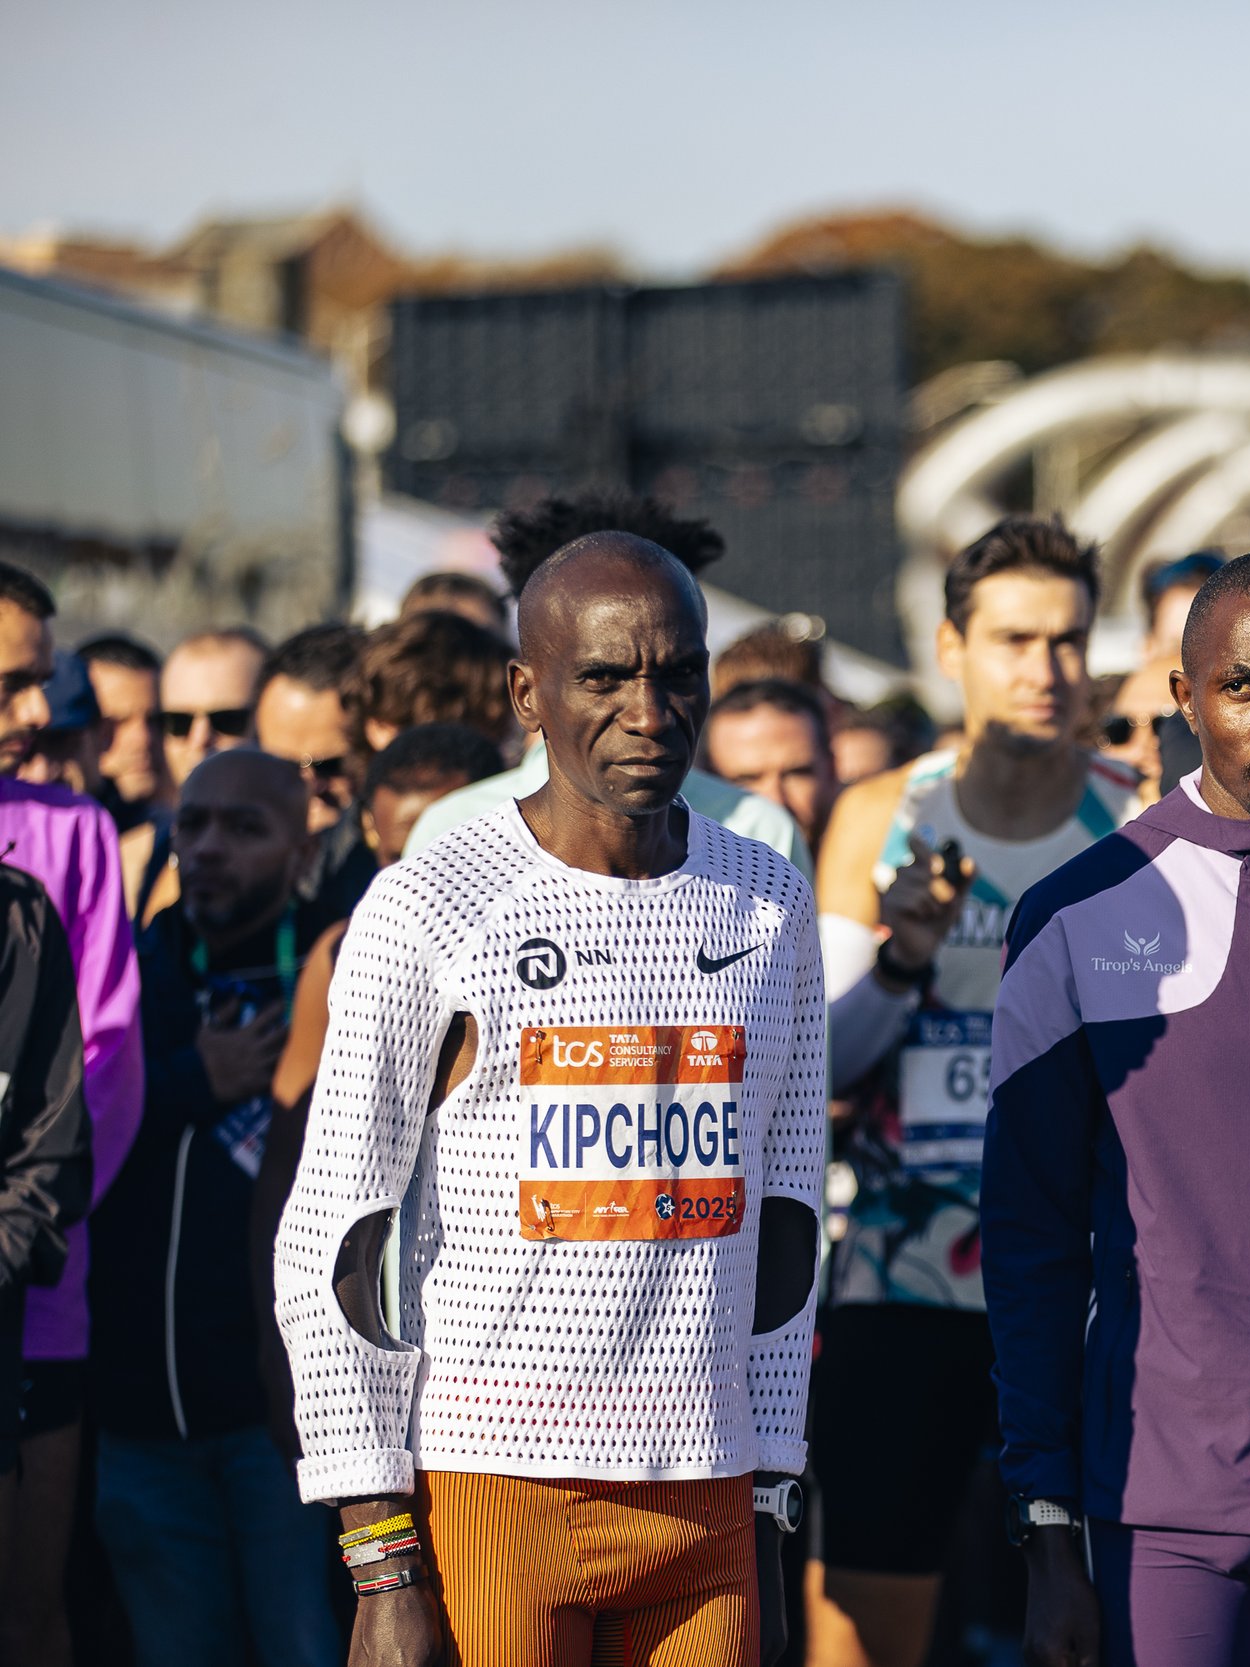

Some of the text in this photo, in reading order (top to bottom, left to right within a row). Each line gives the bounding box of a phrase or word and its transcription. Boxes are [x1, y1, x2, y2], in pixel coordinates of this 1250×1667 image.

[575, 949, 612, 966] NN
[1090, 957, 1192, 974] Tirop's Angels
[609, 1034, 639, 1043] TATA
[553, 1035, 604, 1067] tcs
[609, 1045, 672, 1055] CONSULTANCY
[609, 1057, 654, 1067] SERVICES
[687, 1055, 722, 1066] TATA
[530, 1101, 739, 1169] KIPCHOGE
[681, 1197, 736, 1218] 2025
